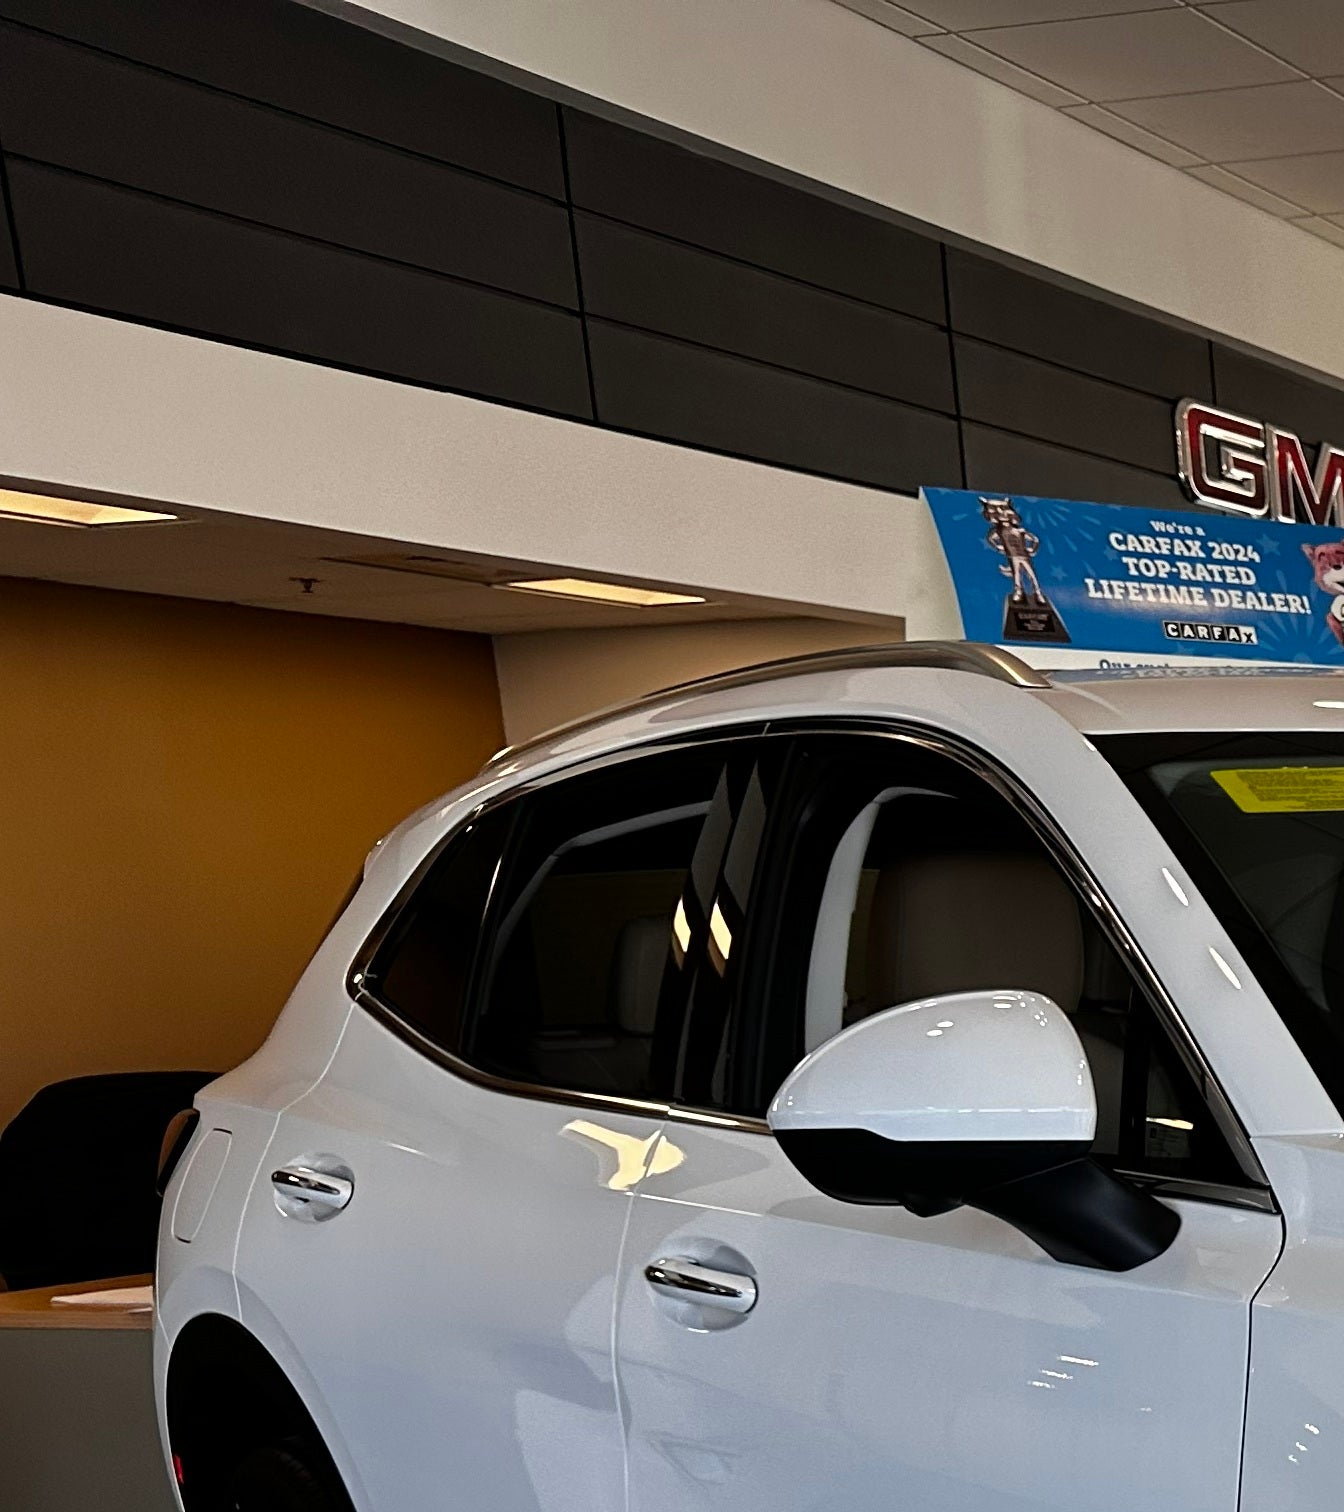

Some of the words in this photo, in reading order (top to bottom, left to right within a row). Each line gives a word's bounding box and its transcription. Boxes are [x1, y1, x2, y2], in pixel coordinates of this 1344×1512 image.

[1150, 520, 1189, 536] We're
[1191, 526, 1206, 537] a
[1109, 532, 1206, 558] CARFAX
[1208, 540, 1261, 564] 2024
[1122, 556, 1257, 586] TOP-RATED
[1085, 578, 1209, 607] LIFETIME
[1211, 589, 1313, 614] DEALER!
[1163, 621, 1258, 645] CARFAX
